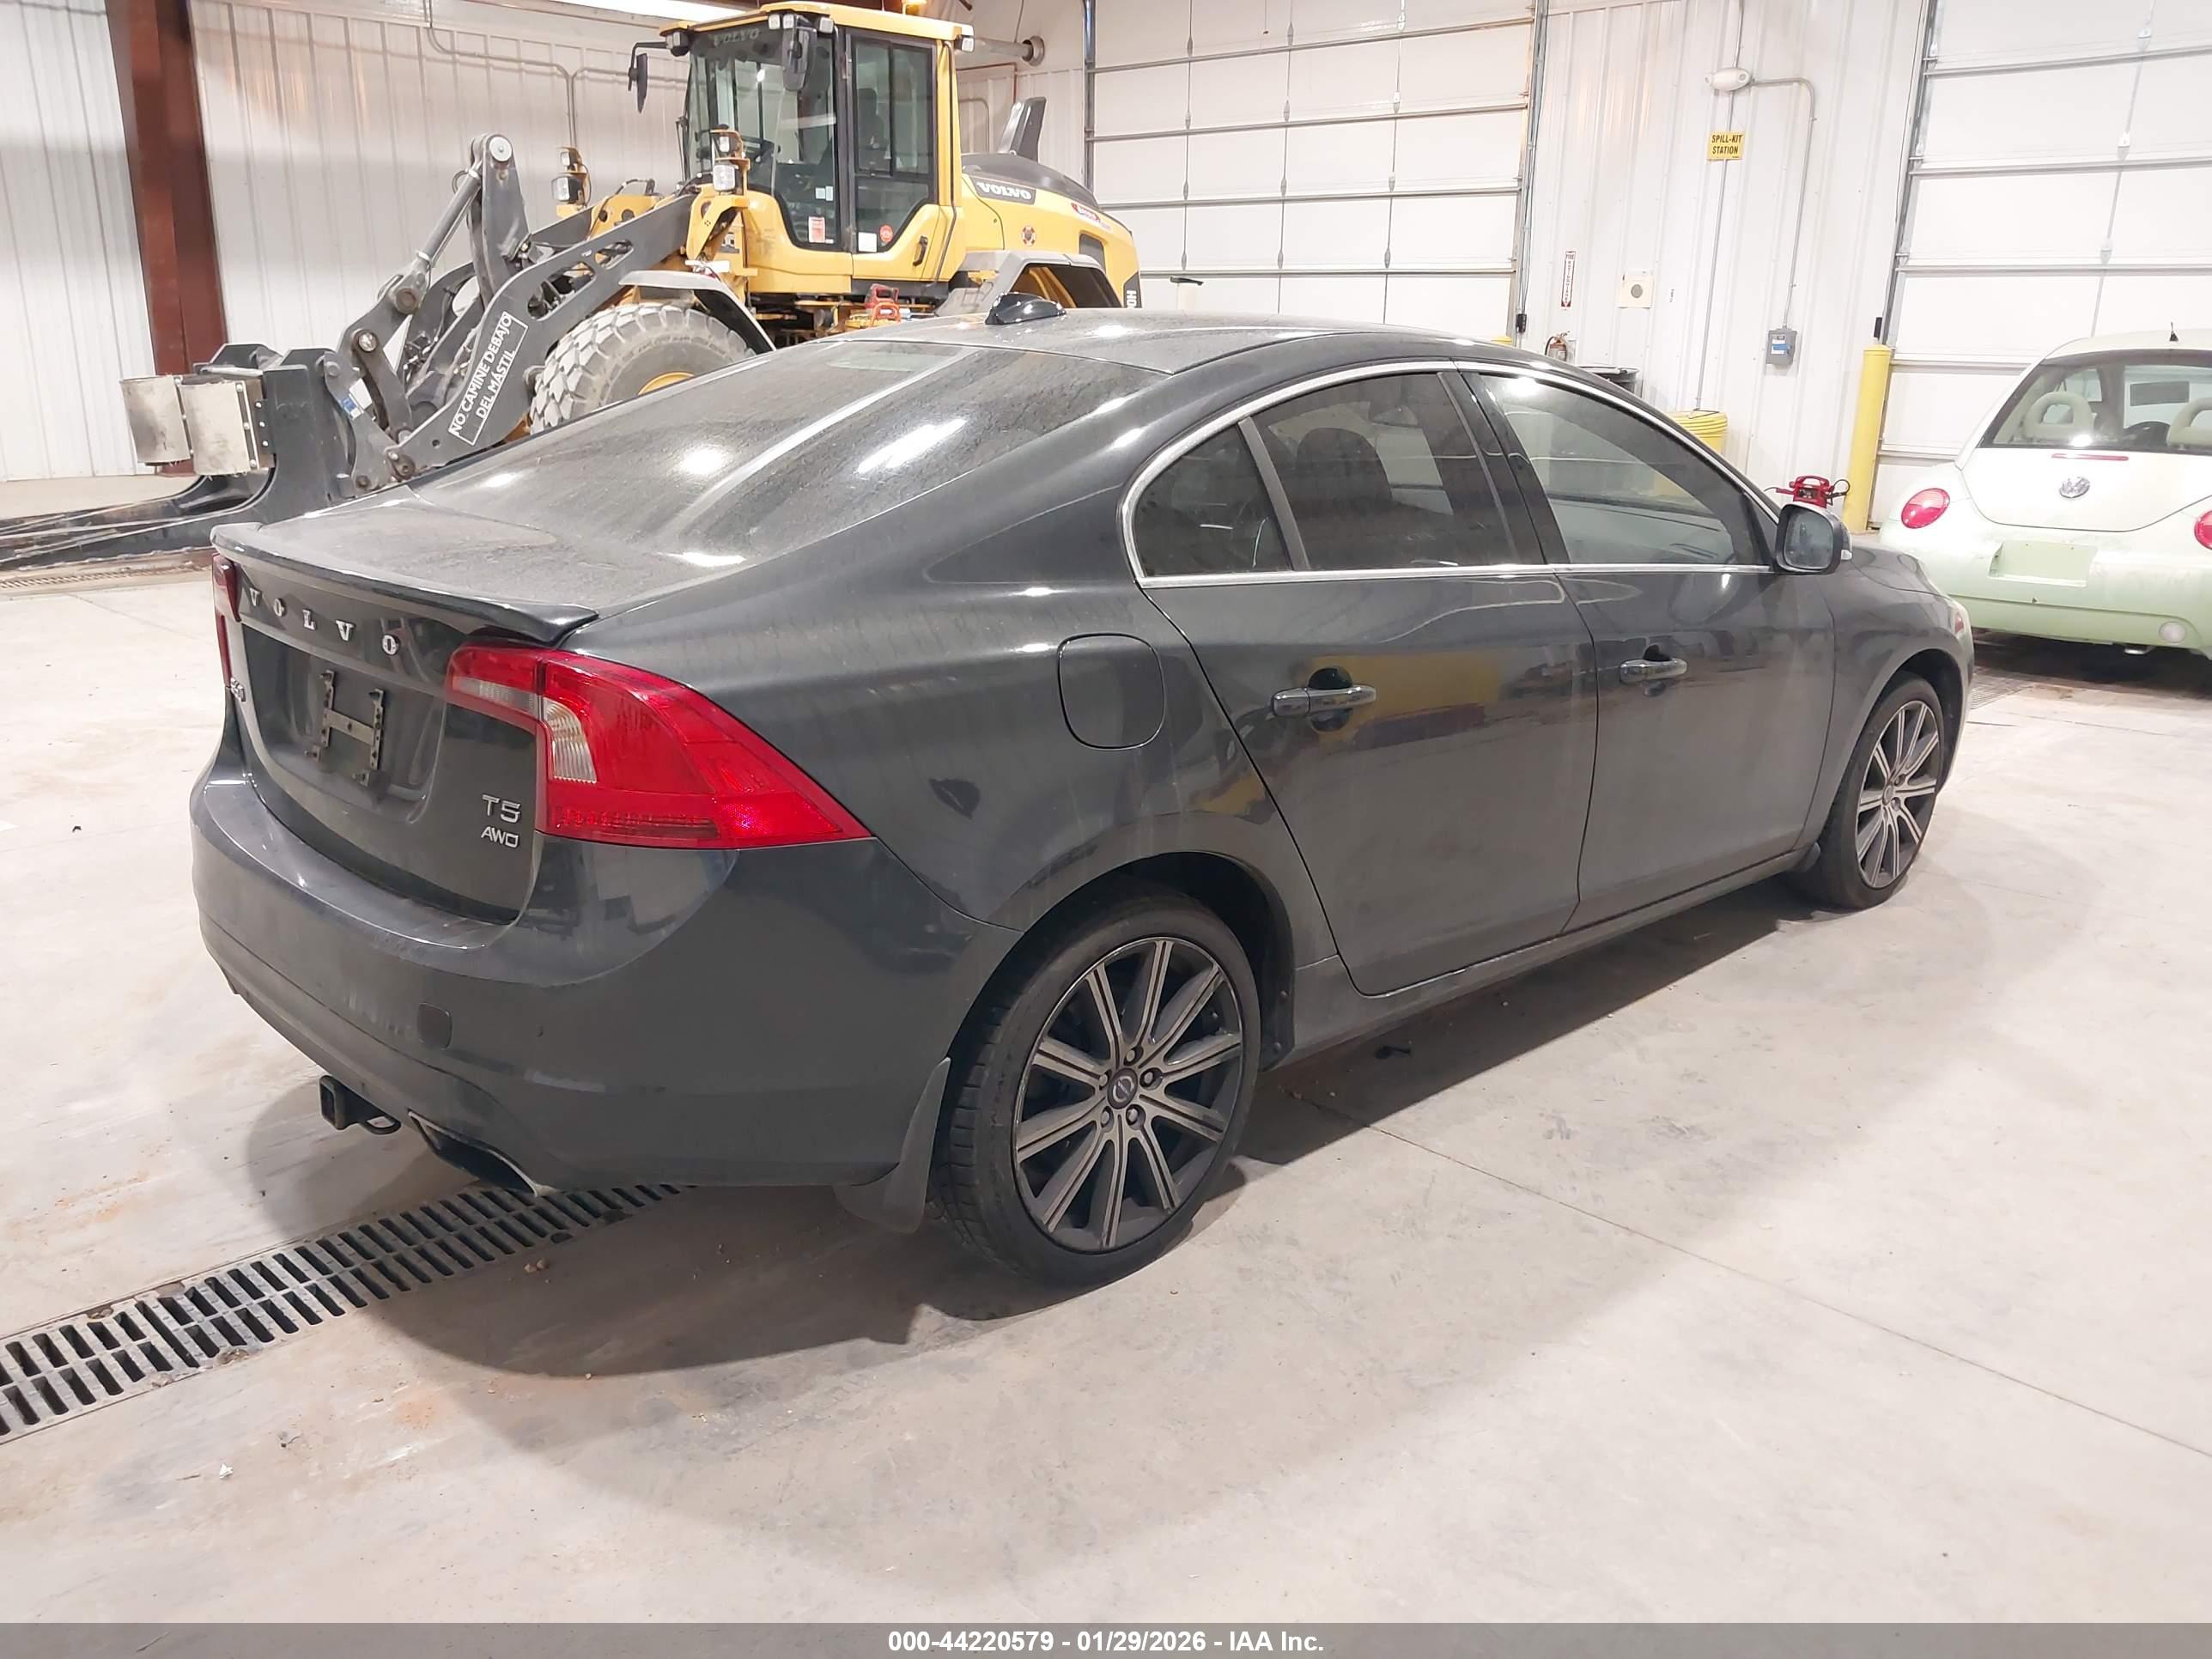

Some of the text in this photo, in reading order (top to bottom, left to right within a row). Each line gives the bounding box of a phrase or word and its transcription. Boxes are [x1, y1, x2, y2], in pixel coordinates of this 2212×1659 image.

[1711, 134, 1742, 143] SPILL-KIT
[1712, 145, 1739, 155] STATION
[976, 181, 1032, 200] VOLVO
[451, 316, 512, 435] NO CAMINE DEBAJO
[476, 349, 515, 418] DEL MÁSTIL
[249, 587, 400, 655] VOLVO
[482, 794, 521, 823] T5
[481, 826, 520, 848] AWD
